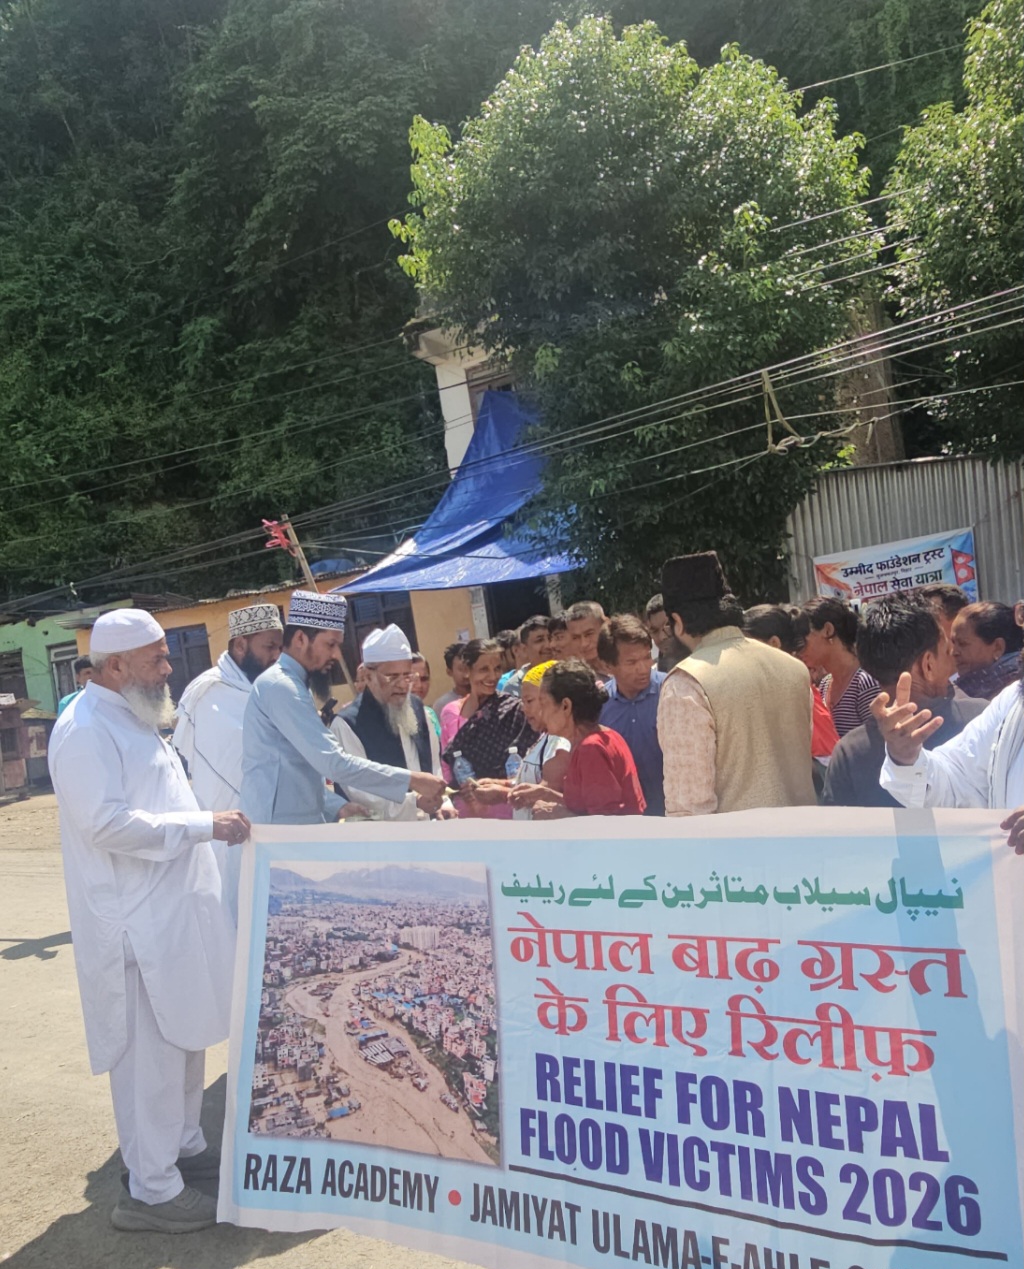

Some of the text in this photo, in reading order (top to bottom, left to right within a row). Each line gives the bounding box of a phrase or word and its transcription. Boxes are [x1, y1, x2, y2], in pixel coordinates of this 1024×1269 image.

[841, 563, 873, 578] उम्मीद
[876, 553, 921, 571] फाउंडेशन
[922, 547, 945, 564] ट्रस्ट
[853, 580, 888, 596] नेपाल
[890, 576, 912, 591] सेवा
[914, 568, 943, 585] यात्रा
[501, 873, 566, 904] ریلیف
[618, 874, 658, 908] کے
[661, 870, 769, 909] متاثرین
[773, 877, 871, 912] سیلاب
[875, 877, 964, 922] نیپال
[507, 911, 968, 998] नेपाल बाढ़ ग्रस्त
[534, 977, 937, 1083] के लिए रिलीफ़
[535, 1052, 950, 1162] RELIEF FOR NEPAL
[520, 1107, 982, 1236] FLOOD VICTIMS 2026
[244, 1153, 312, 1194] RAZA
[321, 1158, 439, 1213] ACADEMY
[470, 1183, 581, 1245] JAMIYAT
